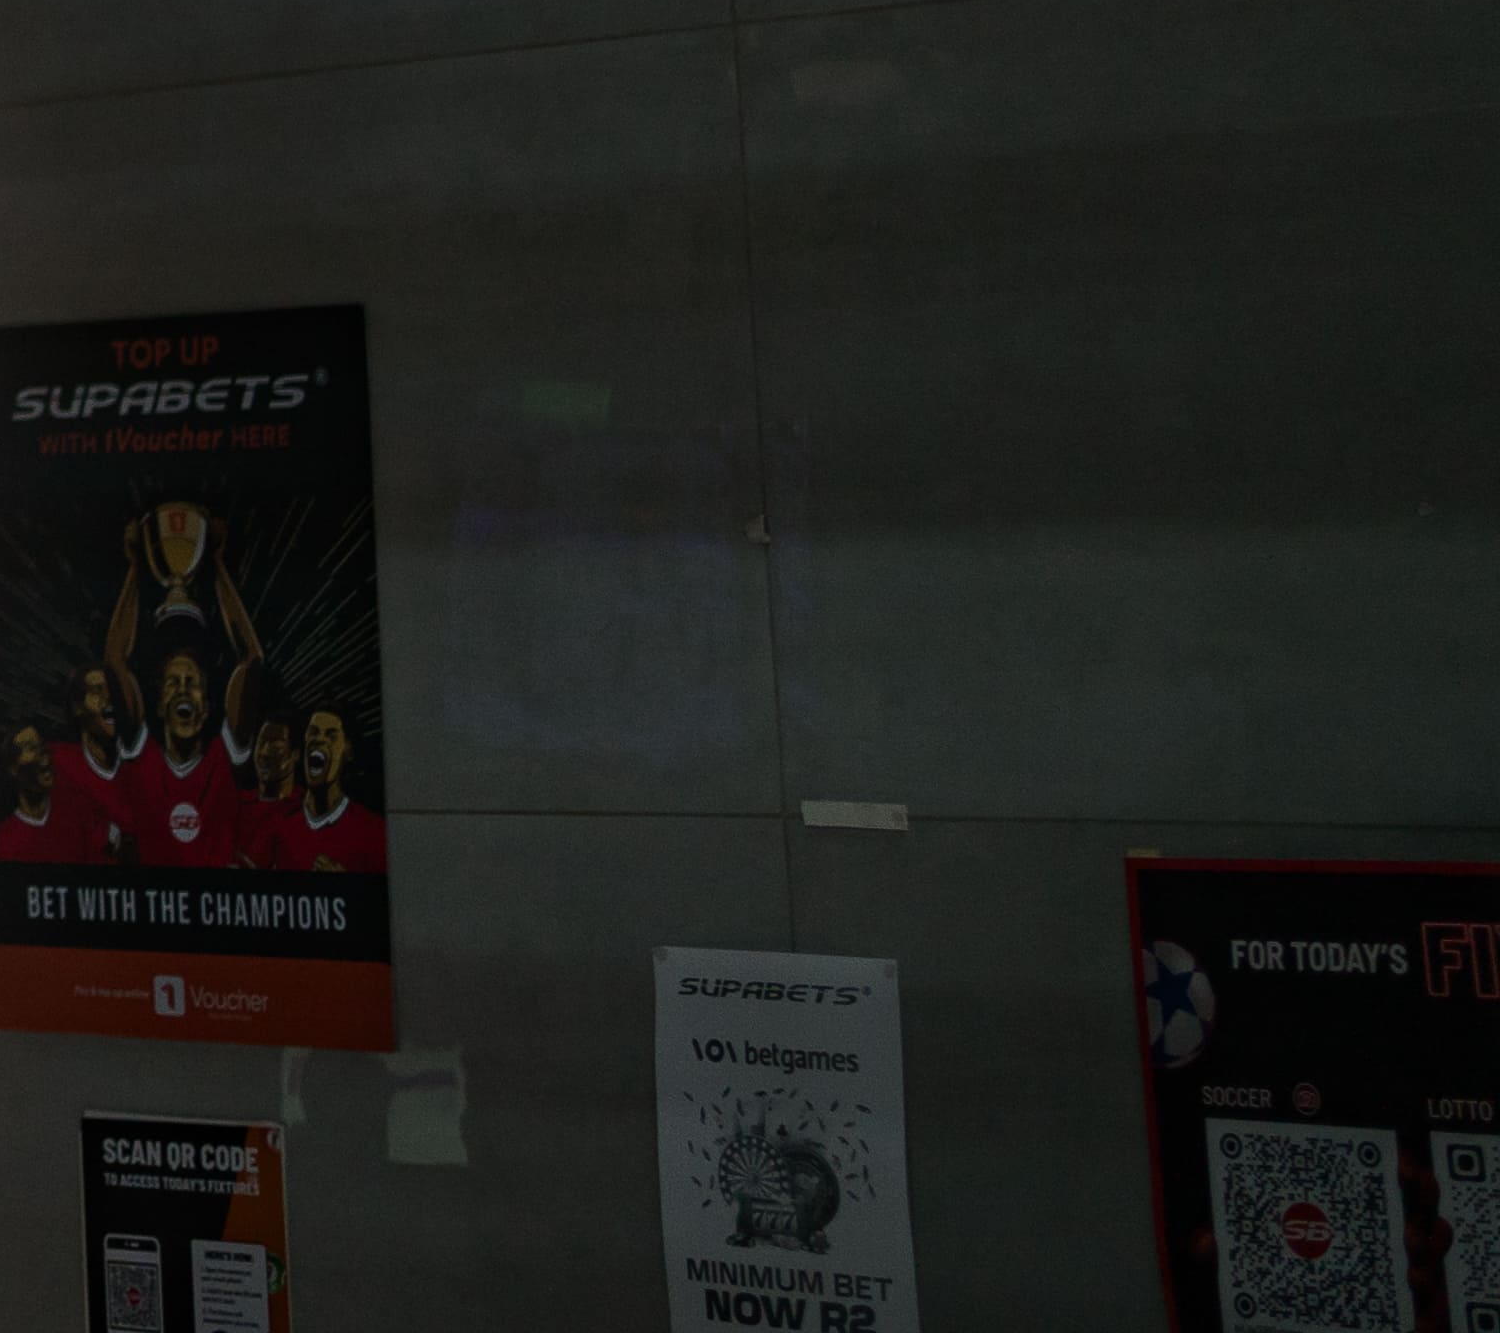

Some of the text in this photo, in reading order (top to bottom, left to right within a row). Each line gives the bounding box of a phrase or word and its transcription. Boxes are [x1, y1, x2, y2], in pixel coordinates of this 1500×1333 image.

[110, 335, 220, 371] TOP UP
[38, 431, 97, 454] WITH
[231, 422, 292, 449] HERE
[27, 886, 348, 932] BET WITH THE CHAMPIONS
[1230, 920, 1500, 998] FOR TODAY'S FI
[191, 985, 268, 1013] Voucher
[744, 1040, 860, 1074] betgames
[1202, 1085, 1494, 1122] SOCCER LOTTO
[102, 1137, 260, 1173] SCAN QR CODE
[103, 1172, 119, 1186] TO
[120, 1174, 160, 1190] ACCESS
[162, 1176, 206, 1193] TODAY'S
[686, 1258, 893, 1301] MINIMUM BET
[705, 1289, 876, 1333] NOW R2
